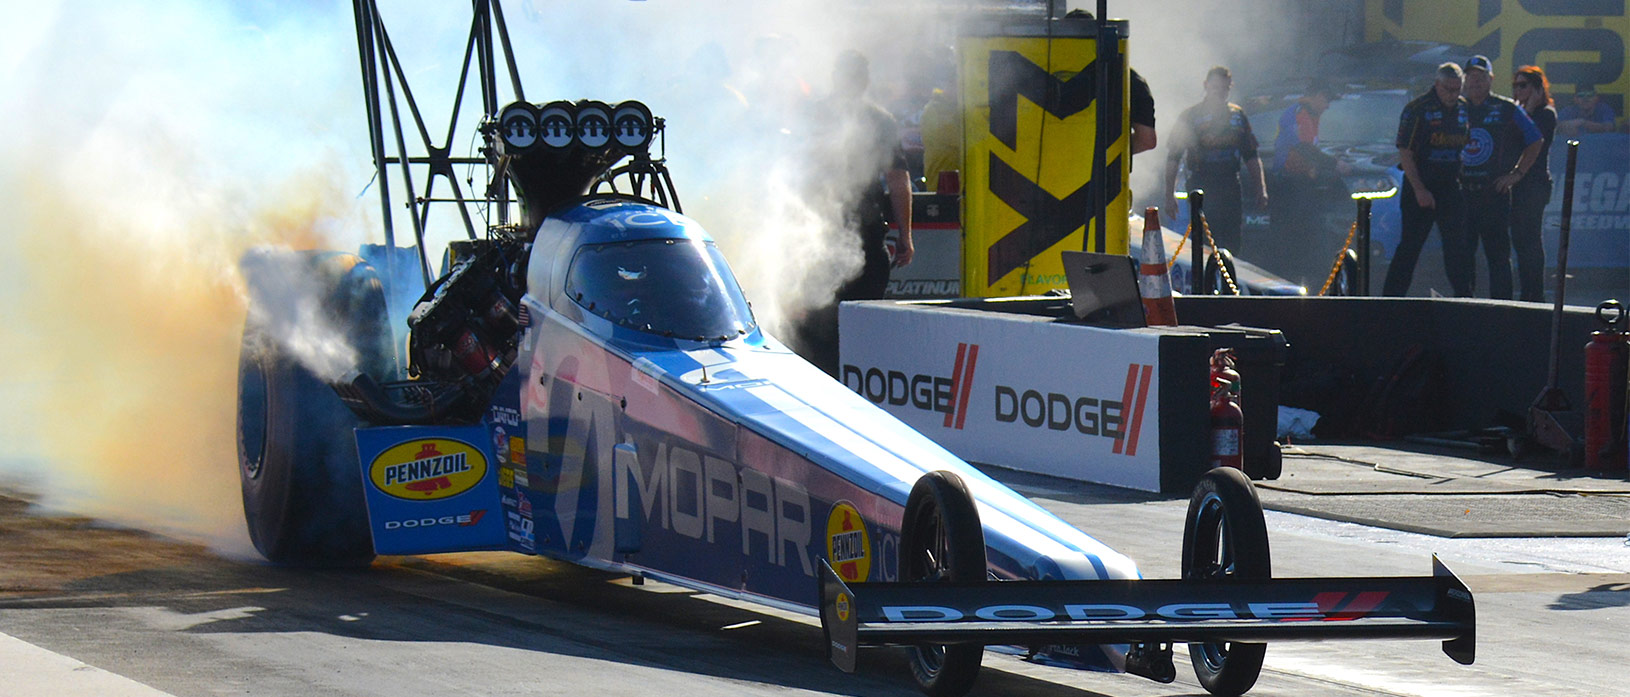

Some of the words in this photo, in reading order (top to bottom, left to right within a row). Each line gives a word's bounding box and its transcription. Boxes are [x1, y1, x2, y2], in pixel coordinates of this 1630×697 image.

[843, 364, 955, 415] DODGE
[995, 385, 1125, 440] DODGE
[385, 452, 471, 486] PENNZOIL
[385, 514, 471, 530] DODGE
[614, 434, 814, 577] MOPAR
[831, 530, 865, 563] PENNZOIL
[881, 602, 1326, 622] DODGE
